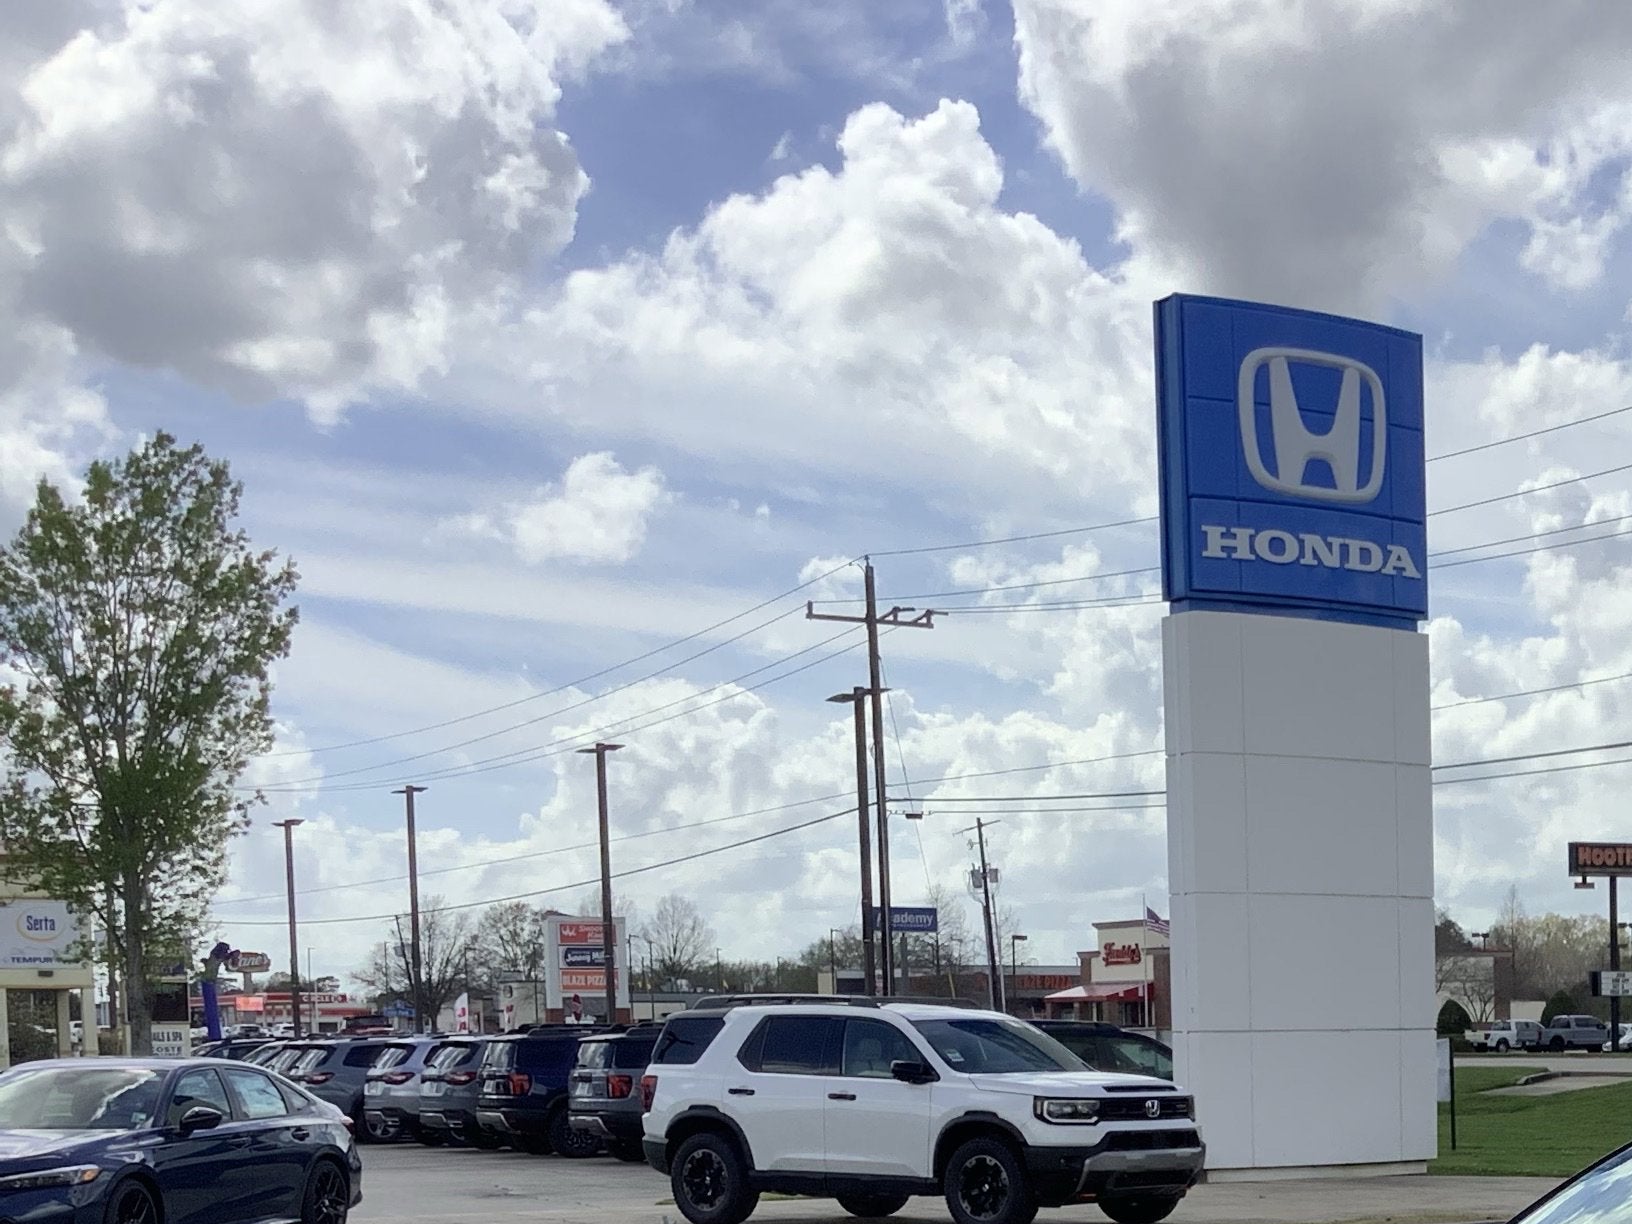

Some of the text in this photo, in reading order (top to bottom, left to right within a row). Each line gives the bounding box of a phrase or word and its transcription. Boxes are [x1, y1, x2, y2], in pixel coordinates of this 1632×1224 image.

[1201, 525, 1421, 579] HONDA
[26, 915, 56, 931] Serta
[877, 912, 934, 927] ademy
